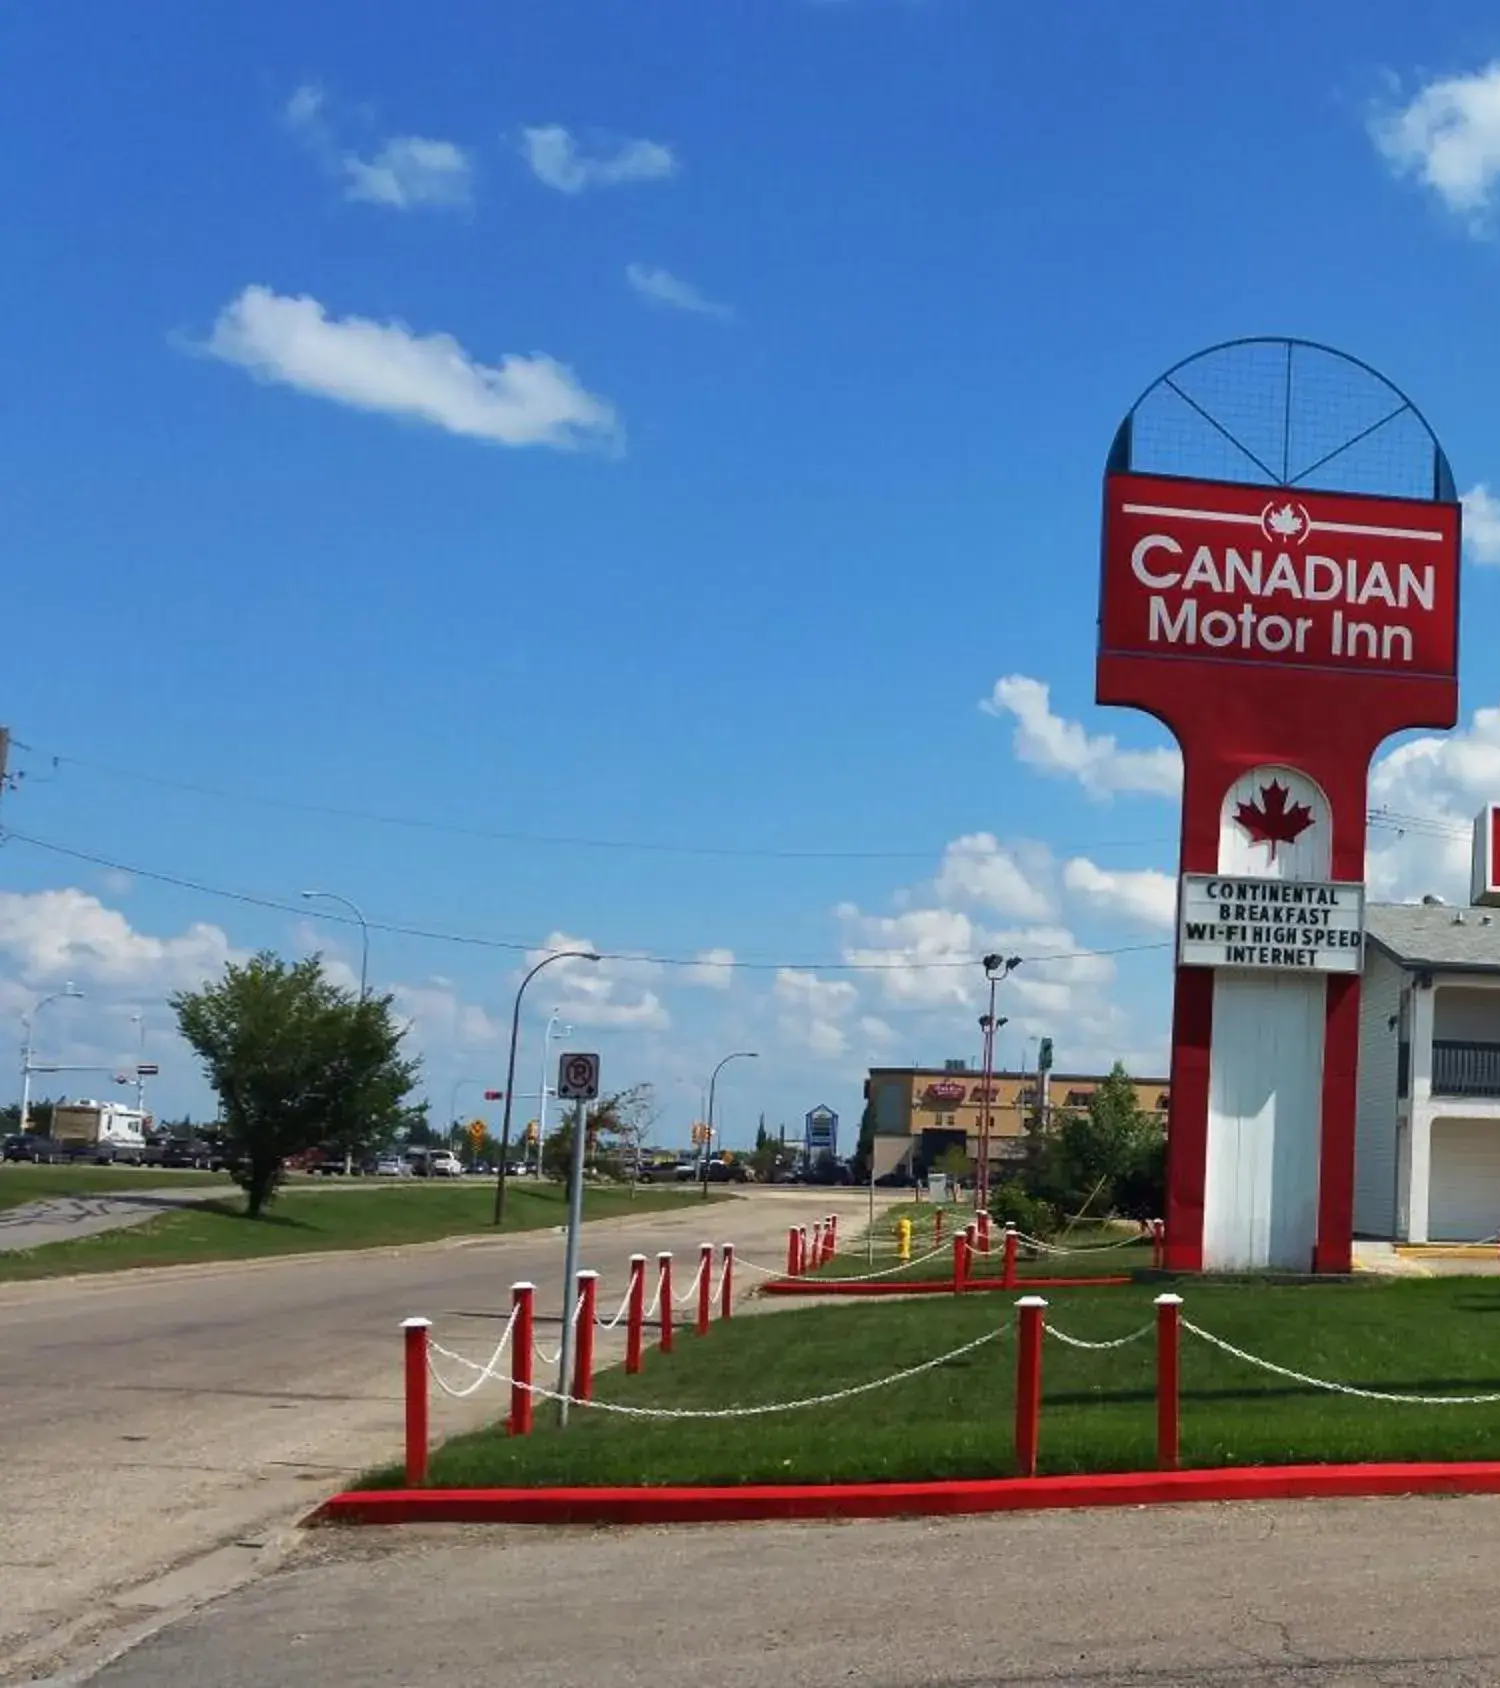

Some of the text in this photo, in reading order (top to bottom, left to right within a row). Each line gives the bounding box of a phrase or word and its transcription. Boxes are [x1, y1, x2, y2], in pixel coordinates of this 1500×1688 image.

[1131, 534, 1436, 611] CANADIAN
[1149, 596, 1413, 661] Motor Inn
[1206, 881, 1340, 906] CONTINENTAL
[1219, 903, 1332, 926] BREAKFAST
[1185, 923, 1362, 947] WI-FI HIGH SPEED
[1226, 946, 1319, 966] INTERNET
